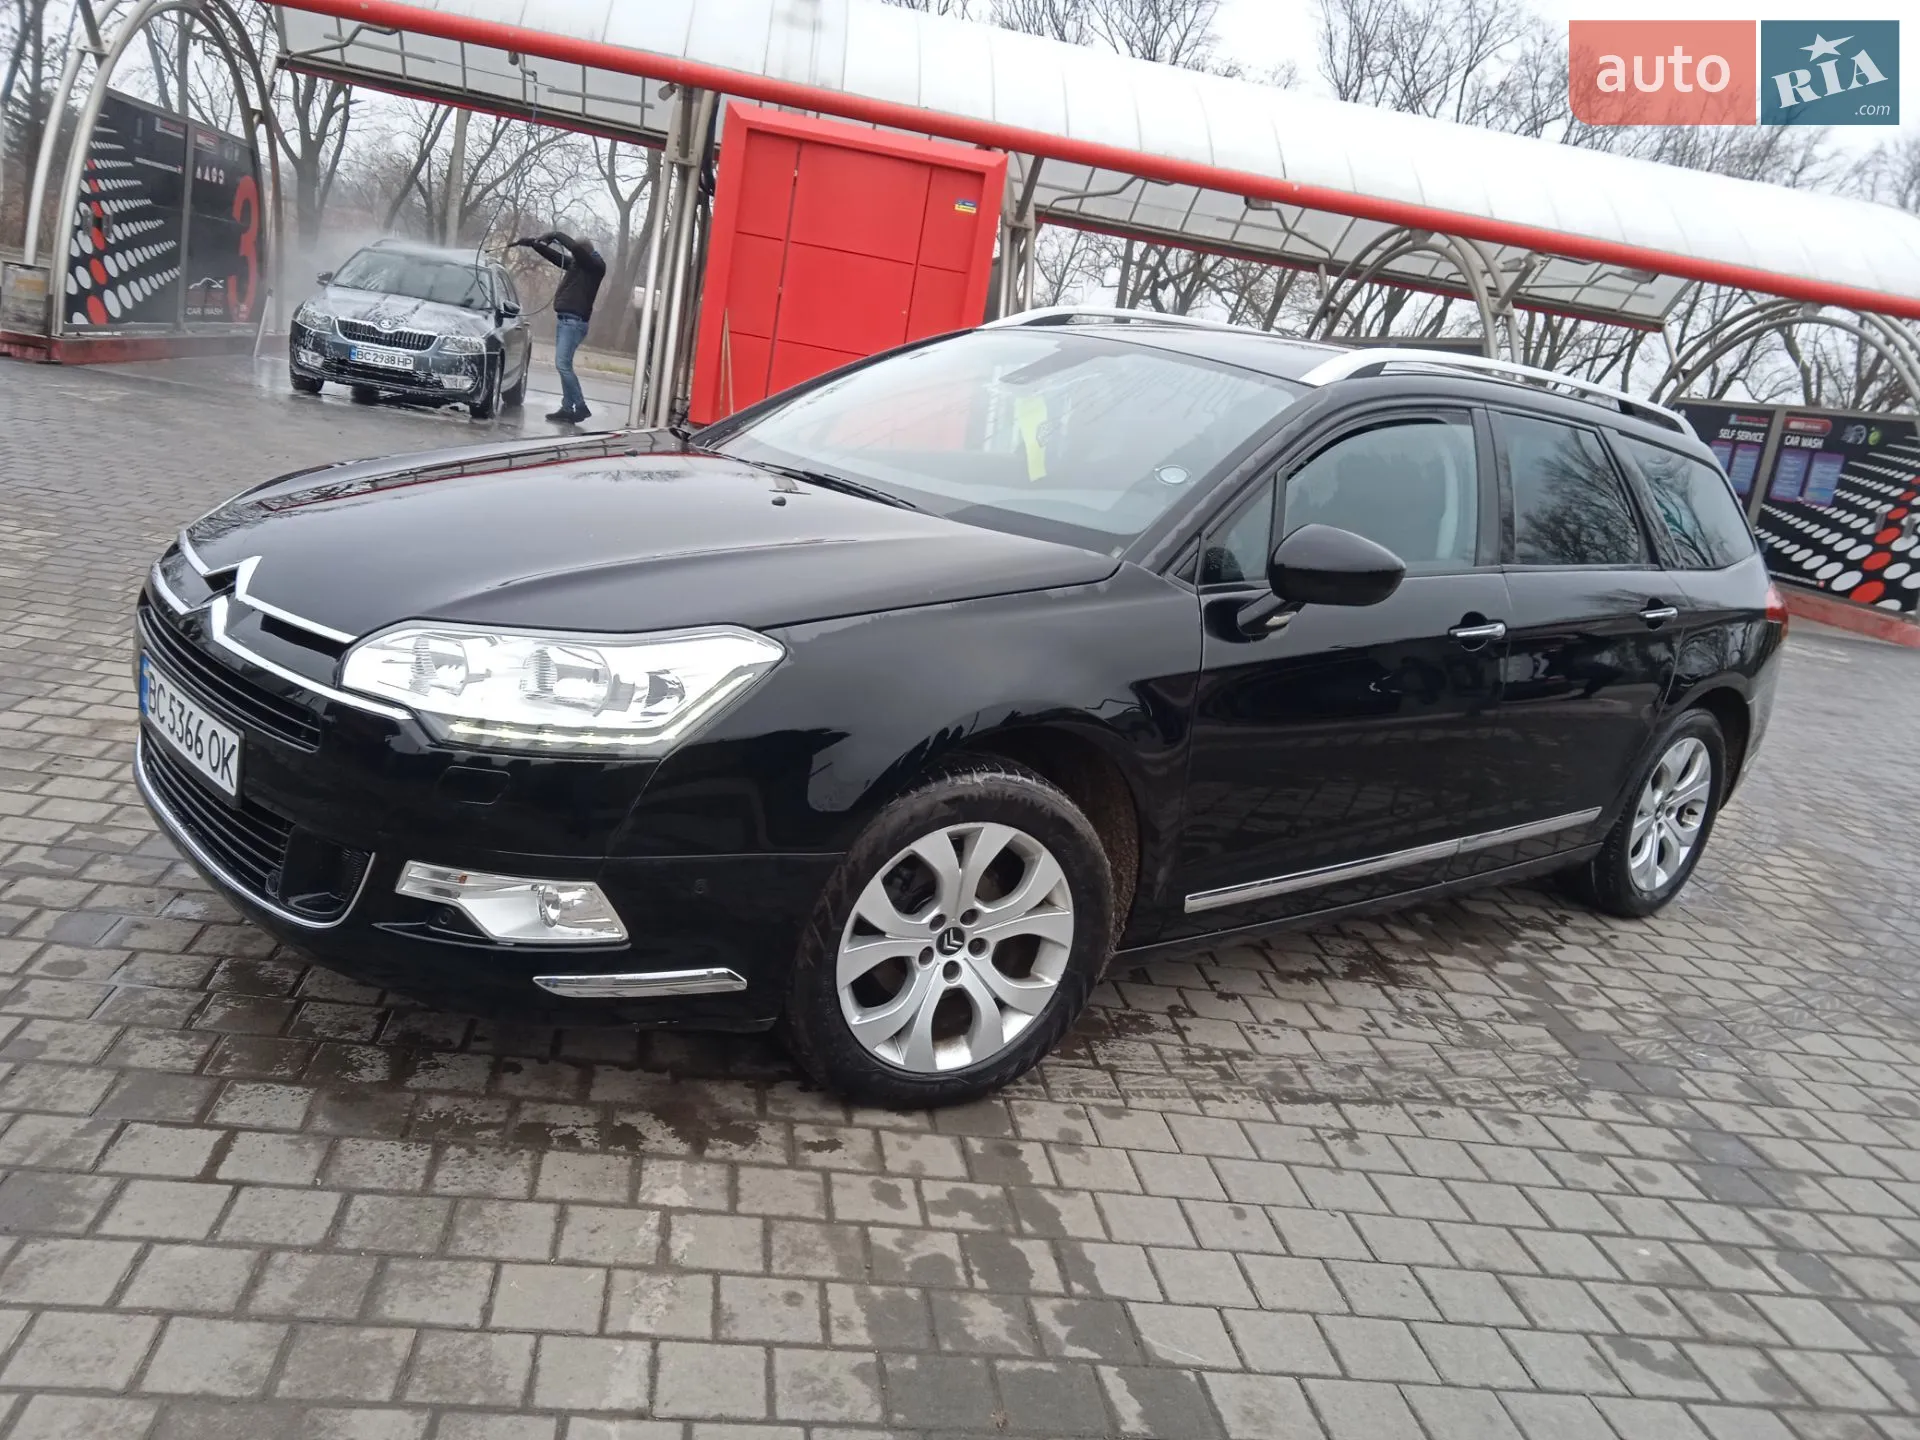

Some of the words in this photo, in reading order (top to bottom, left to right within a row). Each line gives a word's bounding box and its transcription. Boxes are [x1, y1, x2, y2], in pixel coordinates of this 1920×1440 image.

[356, 350, 371, 361] BC
[397, 356, 412, 367] HP
[1718, 428, 1735, 439] SELF
[1736, 430, 1765, 442] SERVICE
[1784, 435, 1800, 446] CAR
[1801, 437, 1824, 448] WASH
[147, 670, 167, 725] BC
[168, 692, 204, 760] 5366
[208, 729, 238, 789] OK
